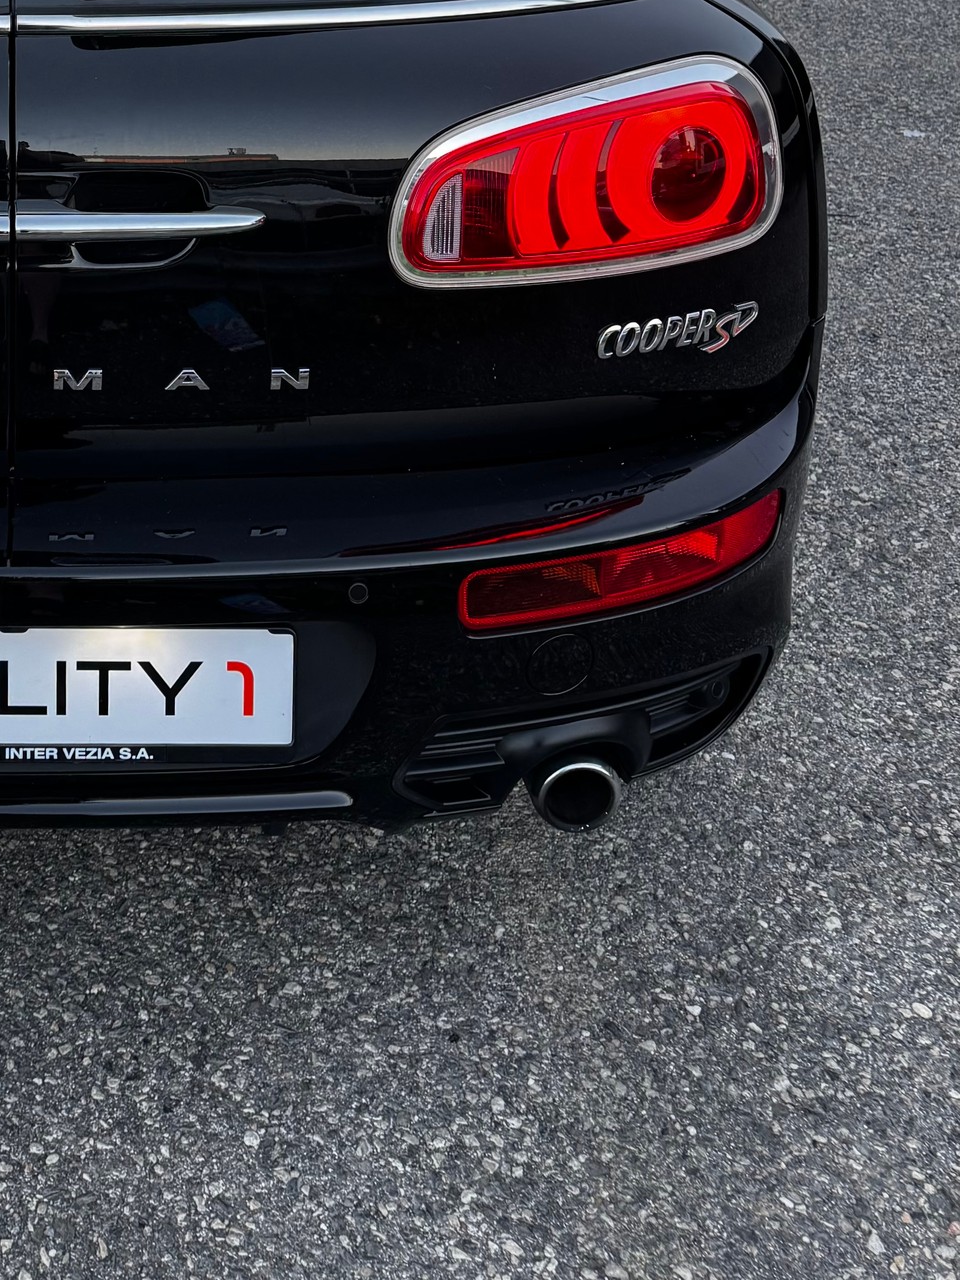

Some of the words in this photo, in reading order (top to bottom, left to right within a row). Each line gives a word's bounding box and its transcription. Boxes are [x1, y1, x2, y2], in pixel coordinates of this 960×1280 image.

[226, 661, 255, 716] 1
[5, 746, 58, 760] INTER
[62, 746, 115, 760] VEZIA
[118, 746, 154, 760] S.A.
